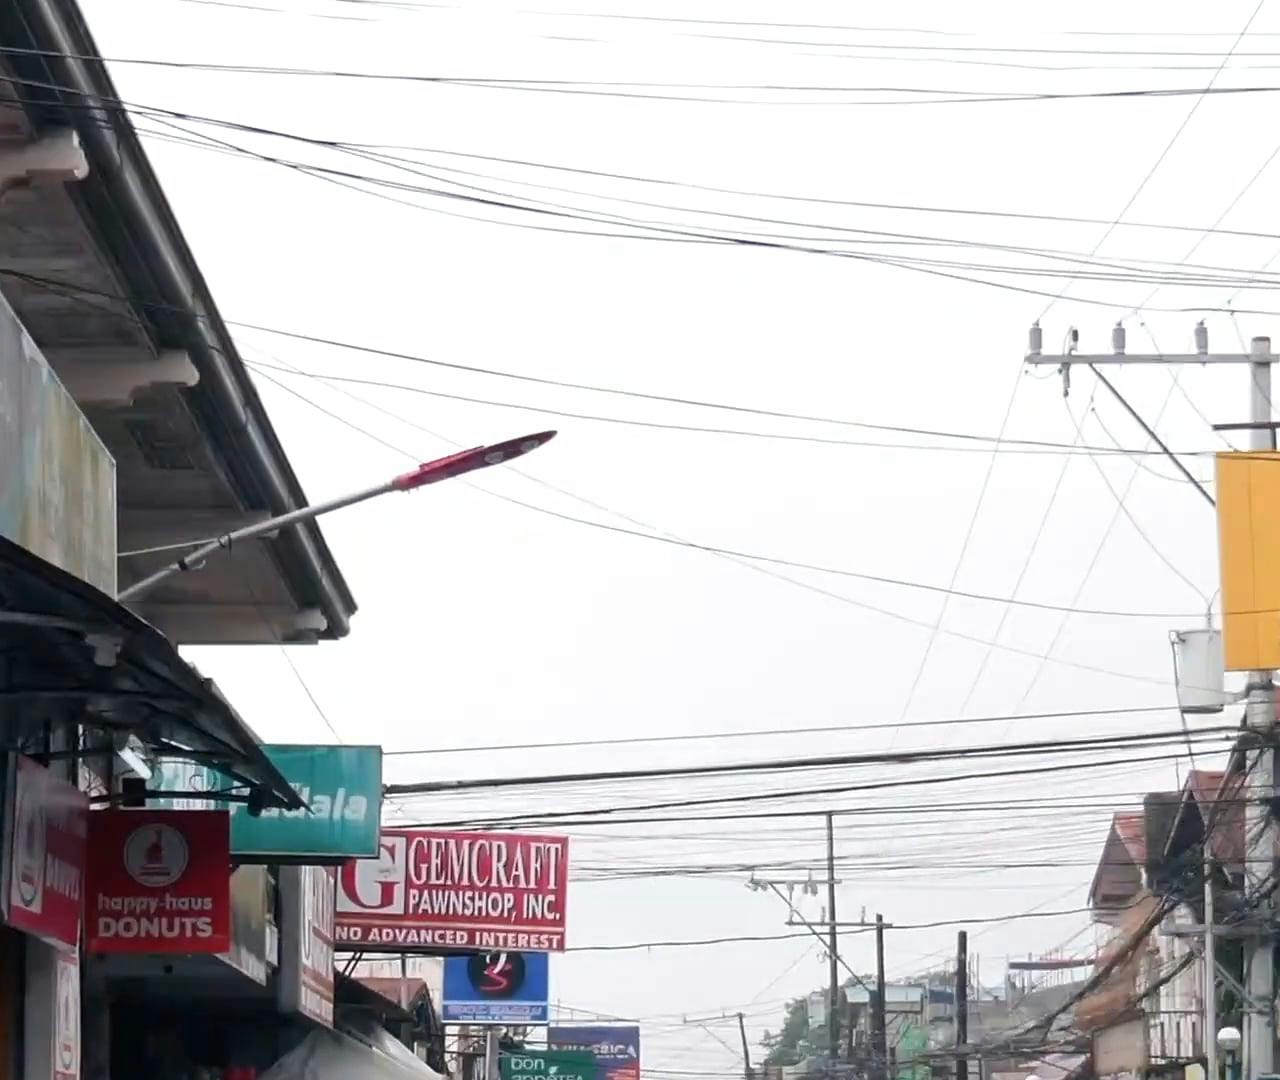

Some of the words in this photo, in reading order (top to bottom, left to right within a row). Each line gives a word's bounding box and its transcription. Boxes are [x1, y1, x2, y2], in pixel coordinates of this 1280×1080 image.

[407, 836, 562, 890] GEMCRAFT
[97, 893, 214, 915] happy-haus
[408, 888, 516, 922] PAWNSHOP,
[522, 894, 562, 921] INC.
[97, 916, 214, 938] DONUTS
[334, 925, 362, 941] NO
[369, 927, 469, 946] ADVANCED
[475, 930, 562, 950] INTEREST
[511, 1056, 545, 1071] bon
